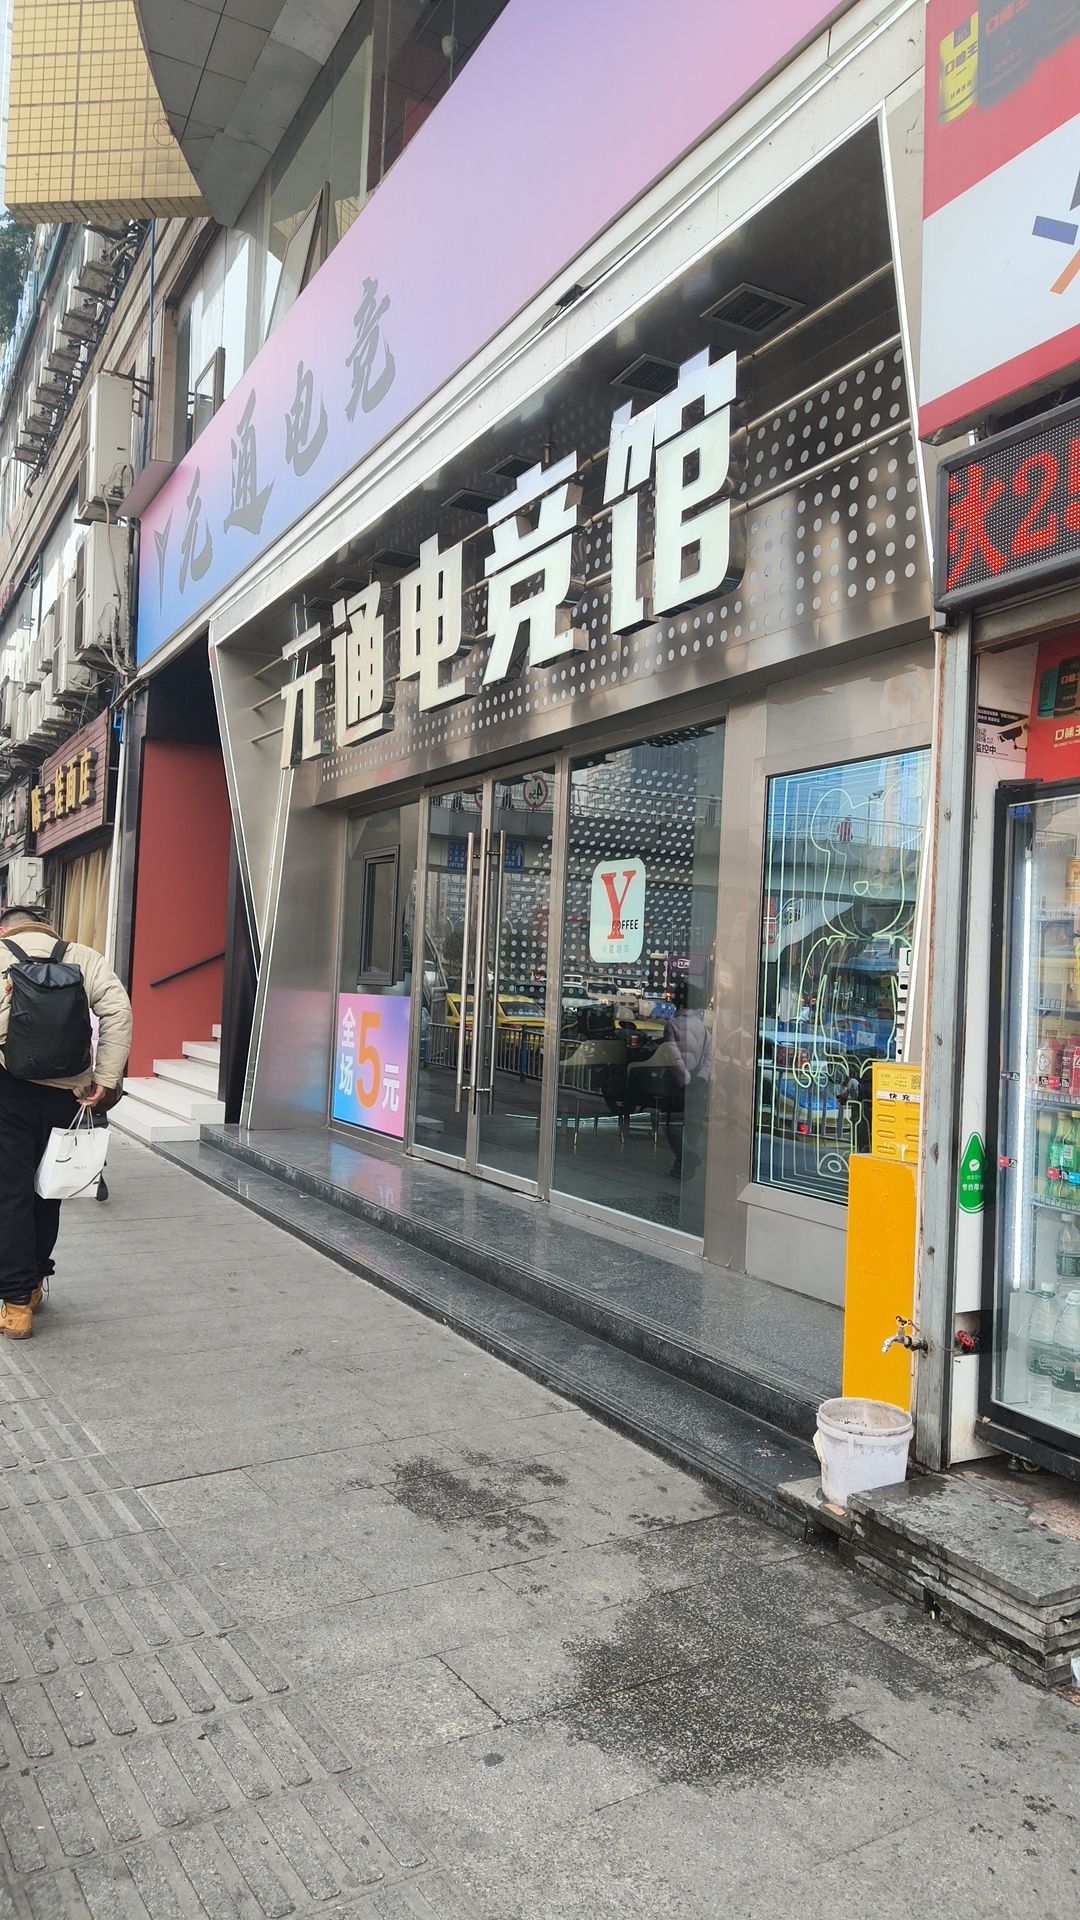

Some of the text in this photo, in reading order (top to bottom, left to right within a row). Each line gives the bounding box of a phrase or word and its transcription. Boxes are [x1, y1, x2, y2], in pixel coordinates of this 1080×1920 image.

[178, 276, 396, 594] 元通电竞
[279, 345, 739, 770] 元通电竞馆
[601, 870, 637, 940] Y
[339, 1006, 400, 1112] 全场 5 元
